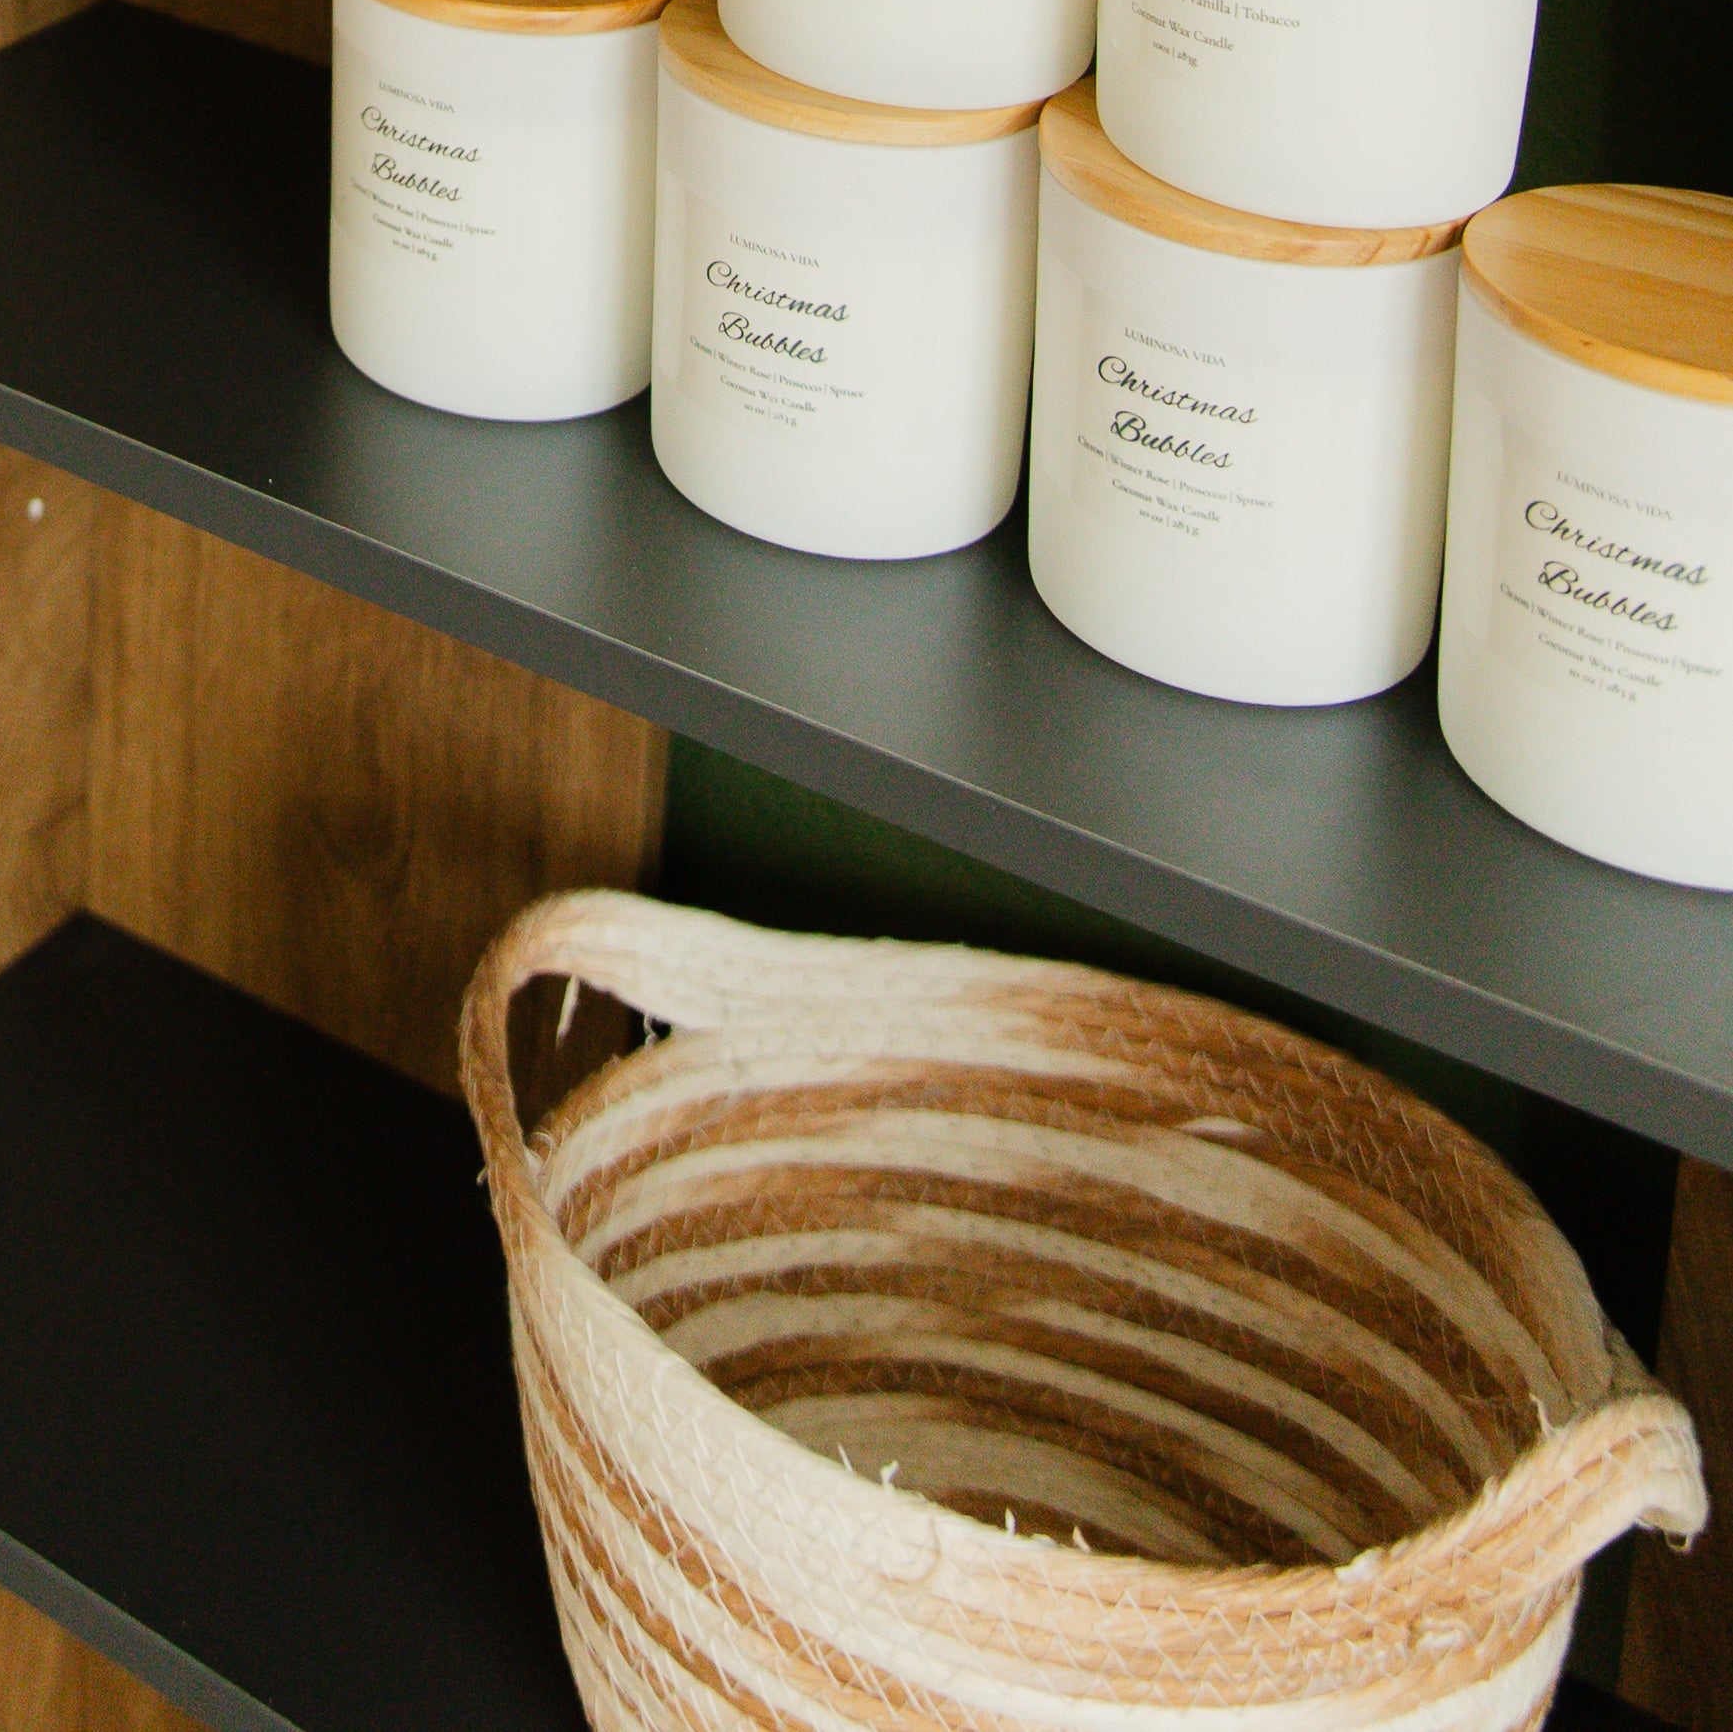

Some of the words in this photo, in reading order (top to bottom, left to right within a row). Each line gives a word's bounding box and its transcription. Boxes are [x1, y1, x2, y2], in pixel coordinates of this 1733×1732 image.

[1131, 1, 1166, 28] Coconut
[1169, 19, 1190, 38] Wax
[1194, 29, 1234, 51] Candle
[1242, 6, 1300, 28] Tobacco
[429, 98, 455, 113] VIDA
[360, 105, 482, 163] Christmas
[370, 152, 462, 202] Bubbles
[729, 233, 787, 261] LUMINOSA
[789, 252, 820, 269] VIDA
[706, 260, 850, 322] Christmas
[718, 311, 827, 364] Bubbles
[1124, 327, 1189, 359] LUMINOSA
[1192, 350, 1227, 368] VIDA
[1097, 355, 1260, 424] Christmas
[1109, 452, 1143, 476] Winter
[1110, 410, 1234, 468] Bubbles
[1155, 495, 1179, 513] Wax
[1557, 471, 1631, 510] LUMINOSA
[1634, 500, 1673, 522] VIDA
[1524, 500, 1710, 585] Christmas
[1535, 603, 1574, 633] Winter
[1537, 560, 1678, 631] Bubbles
